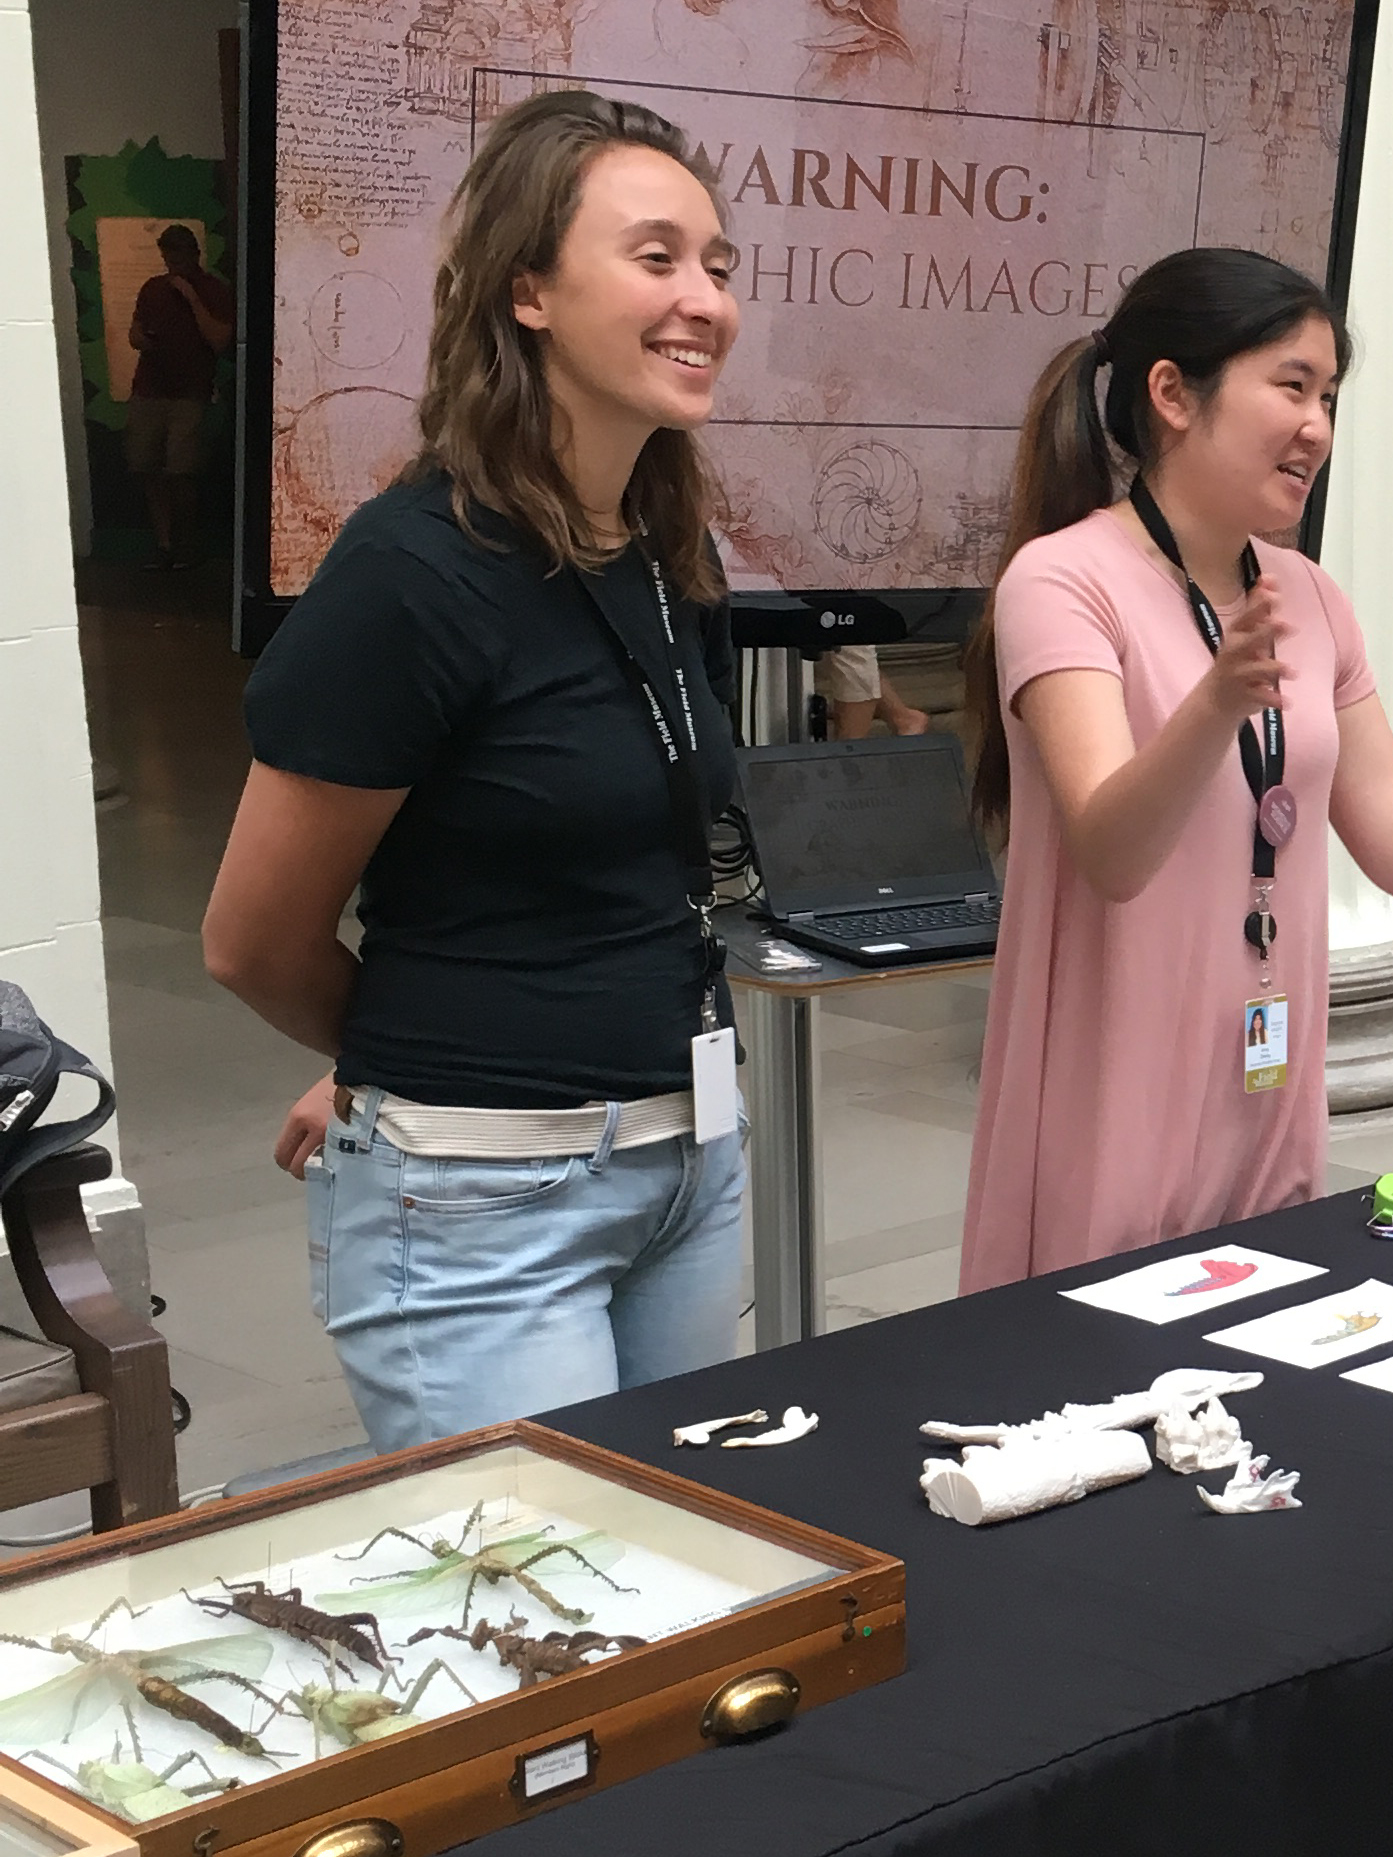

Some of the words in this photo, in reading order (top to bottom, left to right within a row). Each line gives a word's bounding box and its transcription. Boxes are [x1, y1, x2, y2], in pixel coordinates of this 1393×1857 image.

[652, 560, 660, 578] The
[655, 580, 667, 603] Field
[661, 605, 674, 643] Museum
[838, 614, 855, 625] LG
[1199, 603, 1218, 636] Museum
[642, 683, 663, 720] Museum
[675, 668, 684, 685] The
[680, 688, 690, 710] Field
[685, 712, 697, 751] Museum
[657, 721, 672, 745] Field
[1269, 722, 1278, 755] Museum
[668, 744, 678, 764] The
